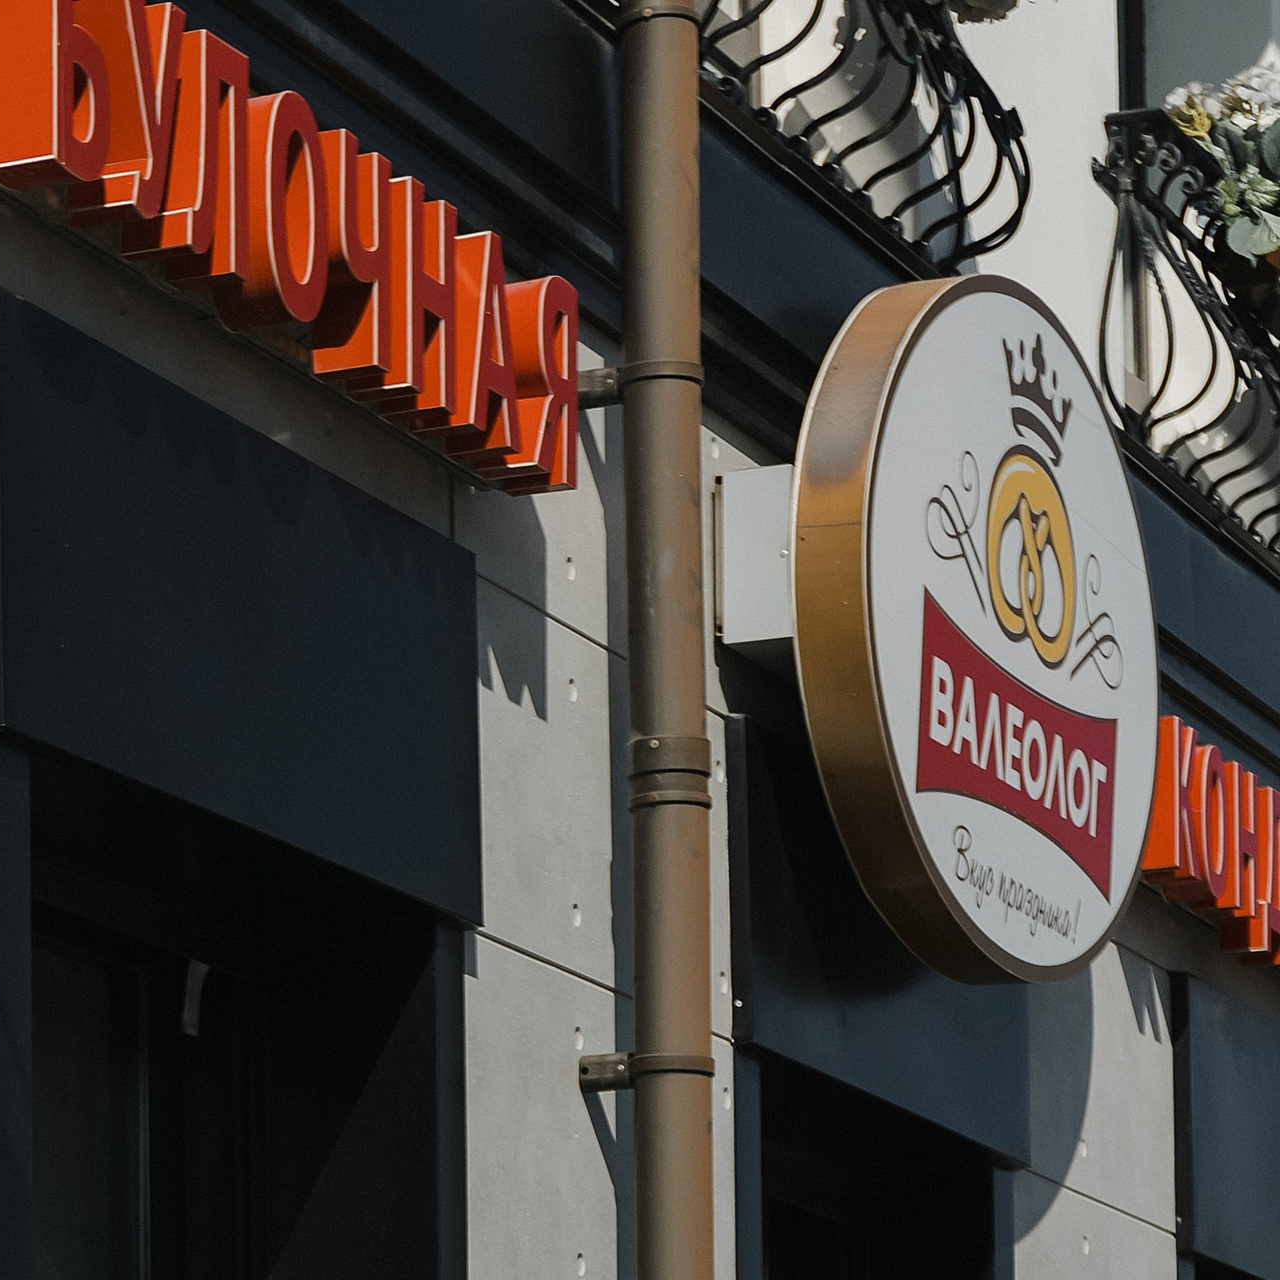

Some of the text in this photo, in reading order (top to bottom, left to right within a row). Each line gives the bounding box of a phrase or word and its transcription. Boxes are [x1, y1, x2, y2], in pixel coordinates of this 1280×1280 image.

[928, 654, 1109, 839] ВАЛЕОЛОГ
[952, 824, 1082, 946] Вкус праздника!
